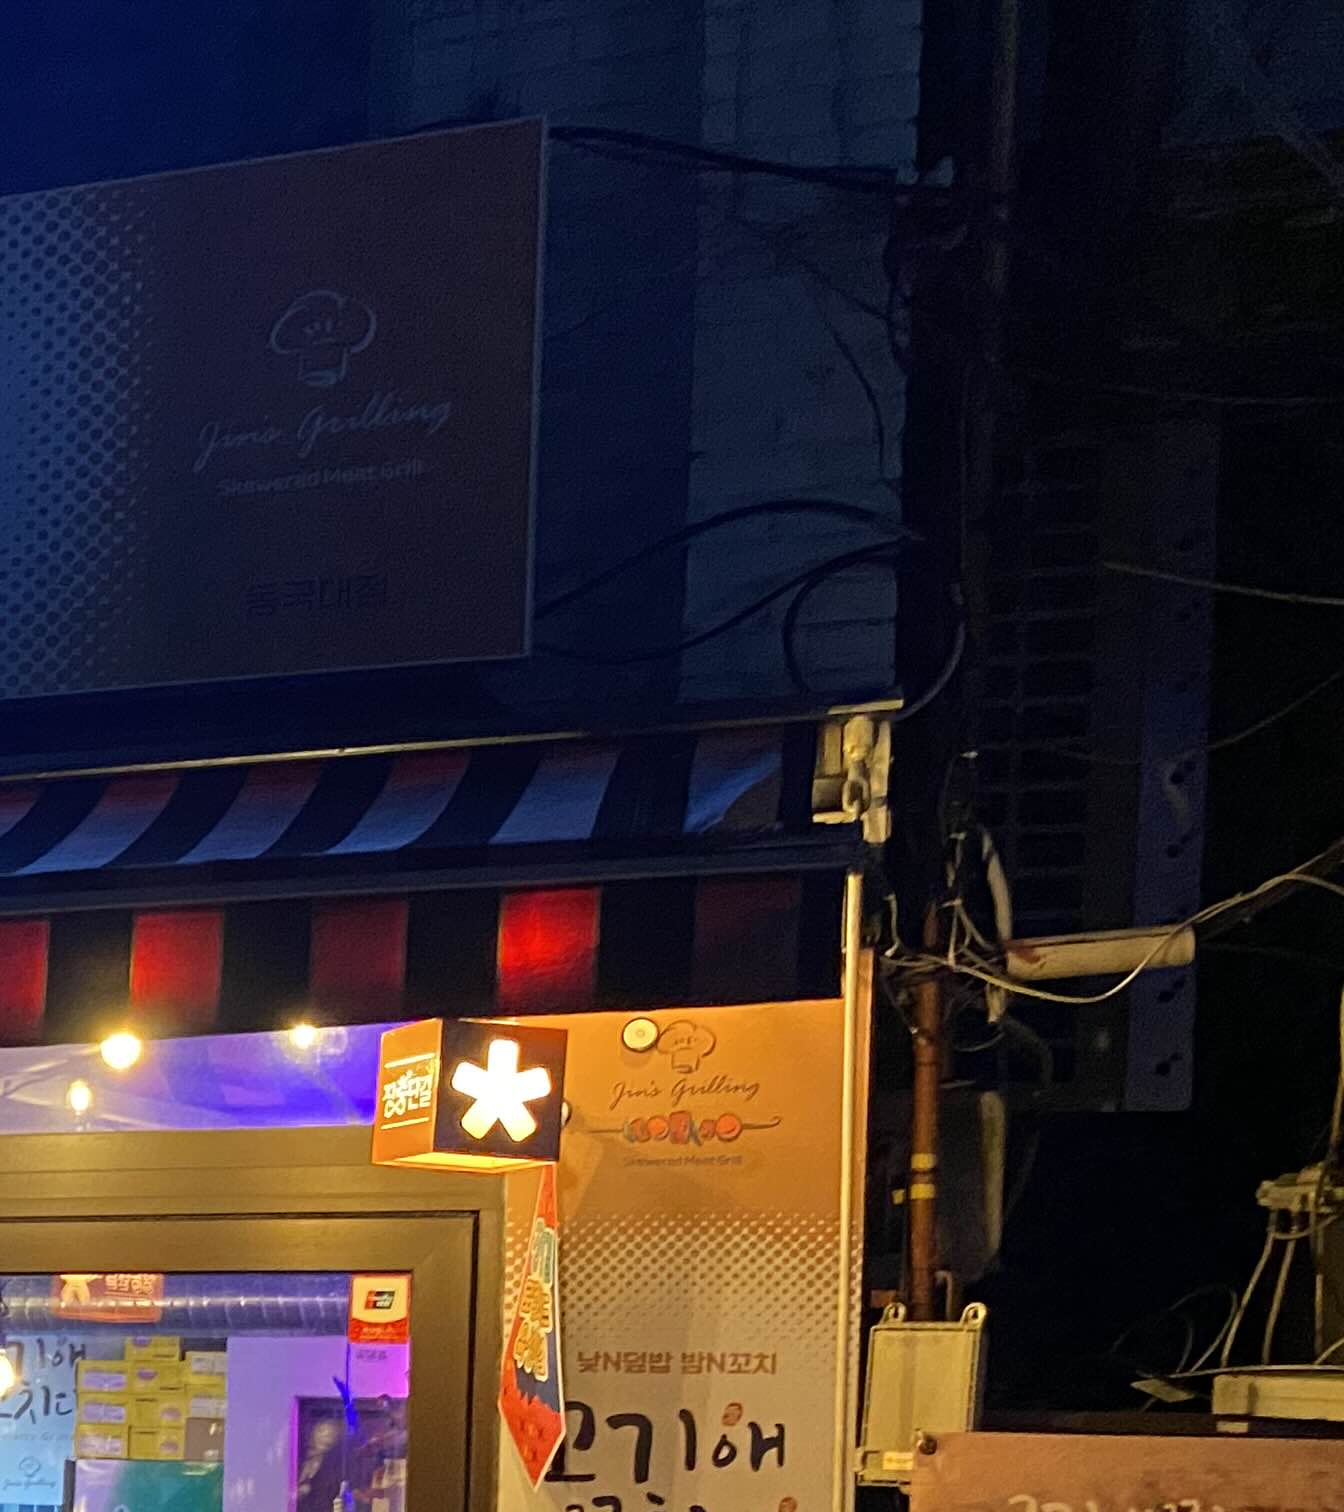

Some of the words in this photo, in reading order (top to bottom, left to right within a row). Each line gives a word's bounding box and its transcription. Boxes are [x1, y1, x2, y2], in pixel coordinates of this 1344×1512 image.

[296, 389, 452, 460] Grilling
[670, 1075, 762, 1107] Grilling
[577, 1350, 675, 1375] 낮N덮밥
[680, 1351, 778, 1376] 밤N꼬치
